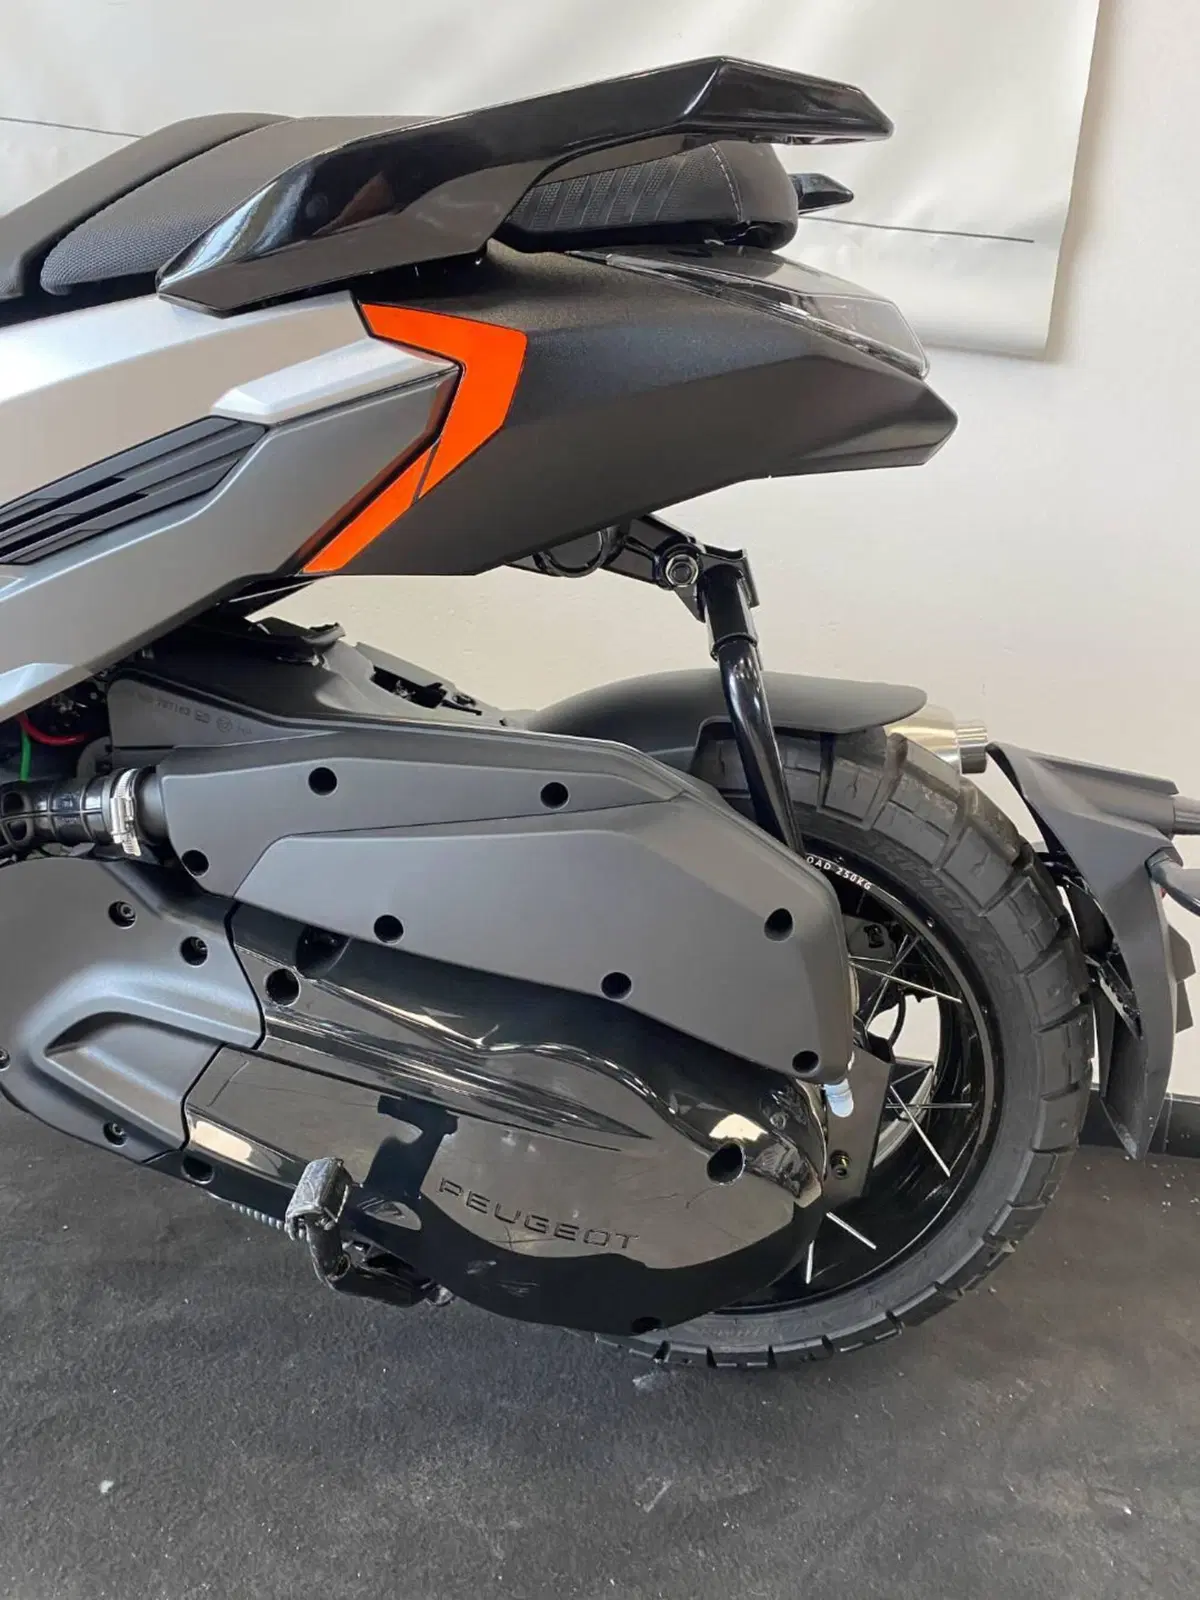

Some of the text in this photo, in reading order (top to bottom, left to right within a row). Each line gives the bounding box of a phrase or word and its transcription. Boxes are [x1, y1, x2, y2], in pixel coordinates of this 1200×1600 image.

[805, 855, 872, 890] OAD 250KG
[438, 1176, 640, 1250] PEUGEOT
